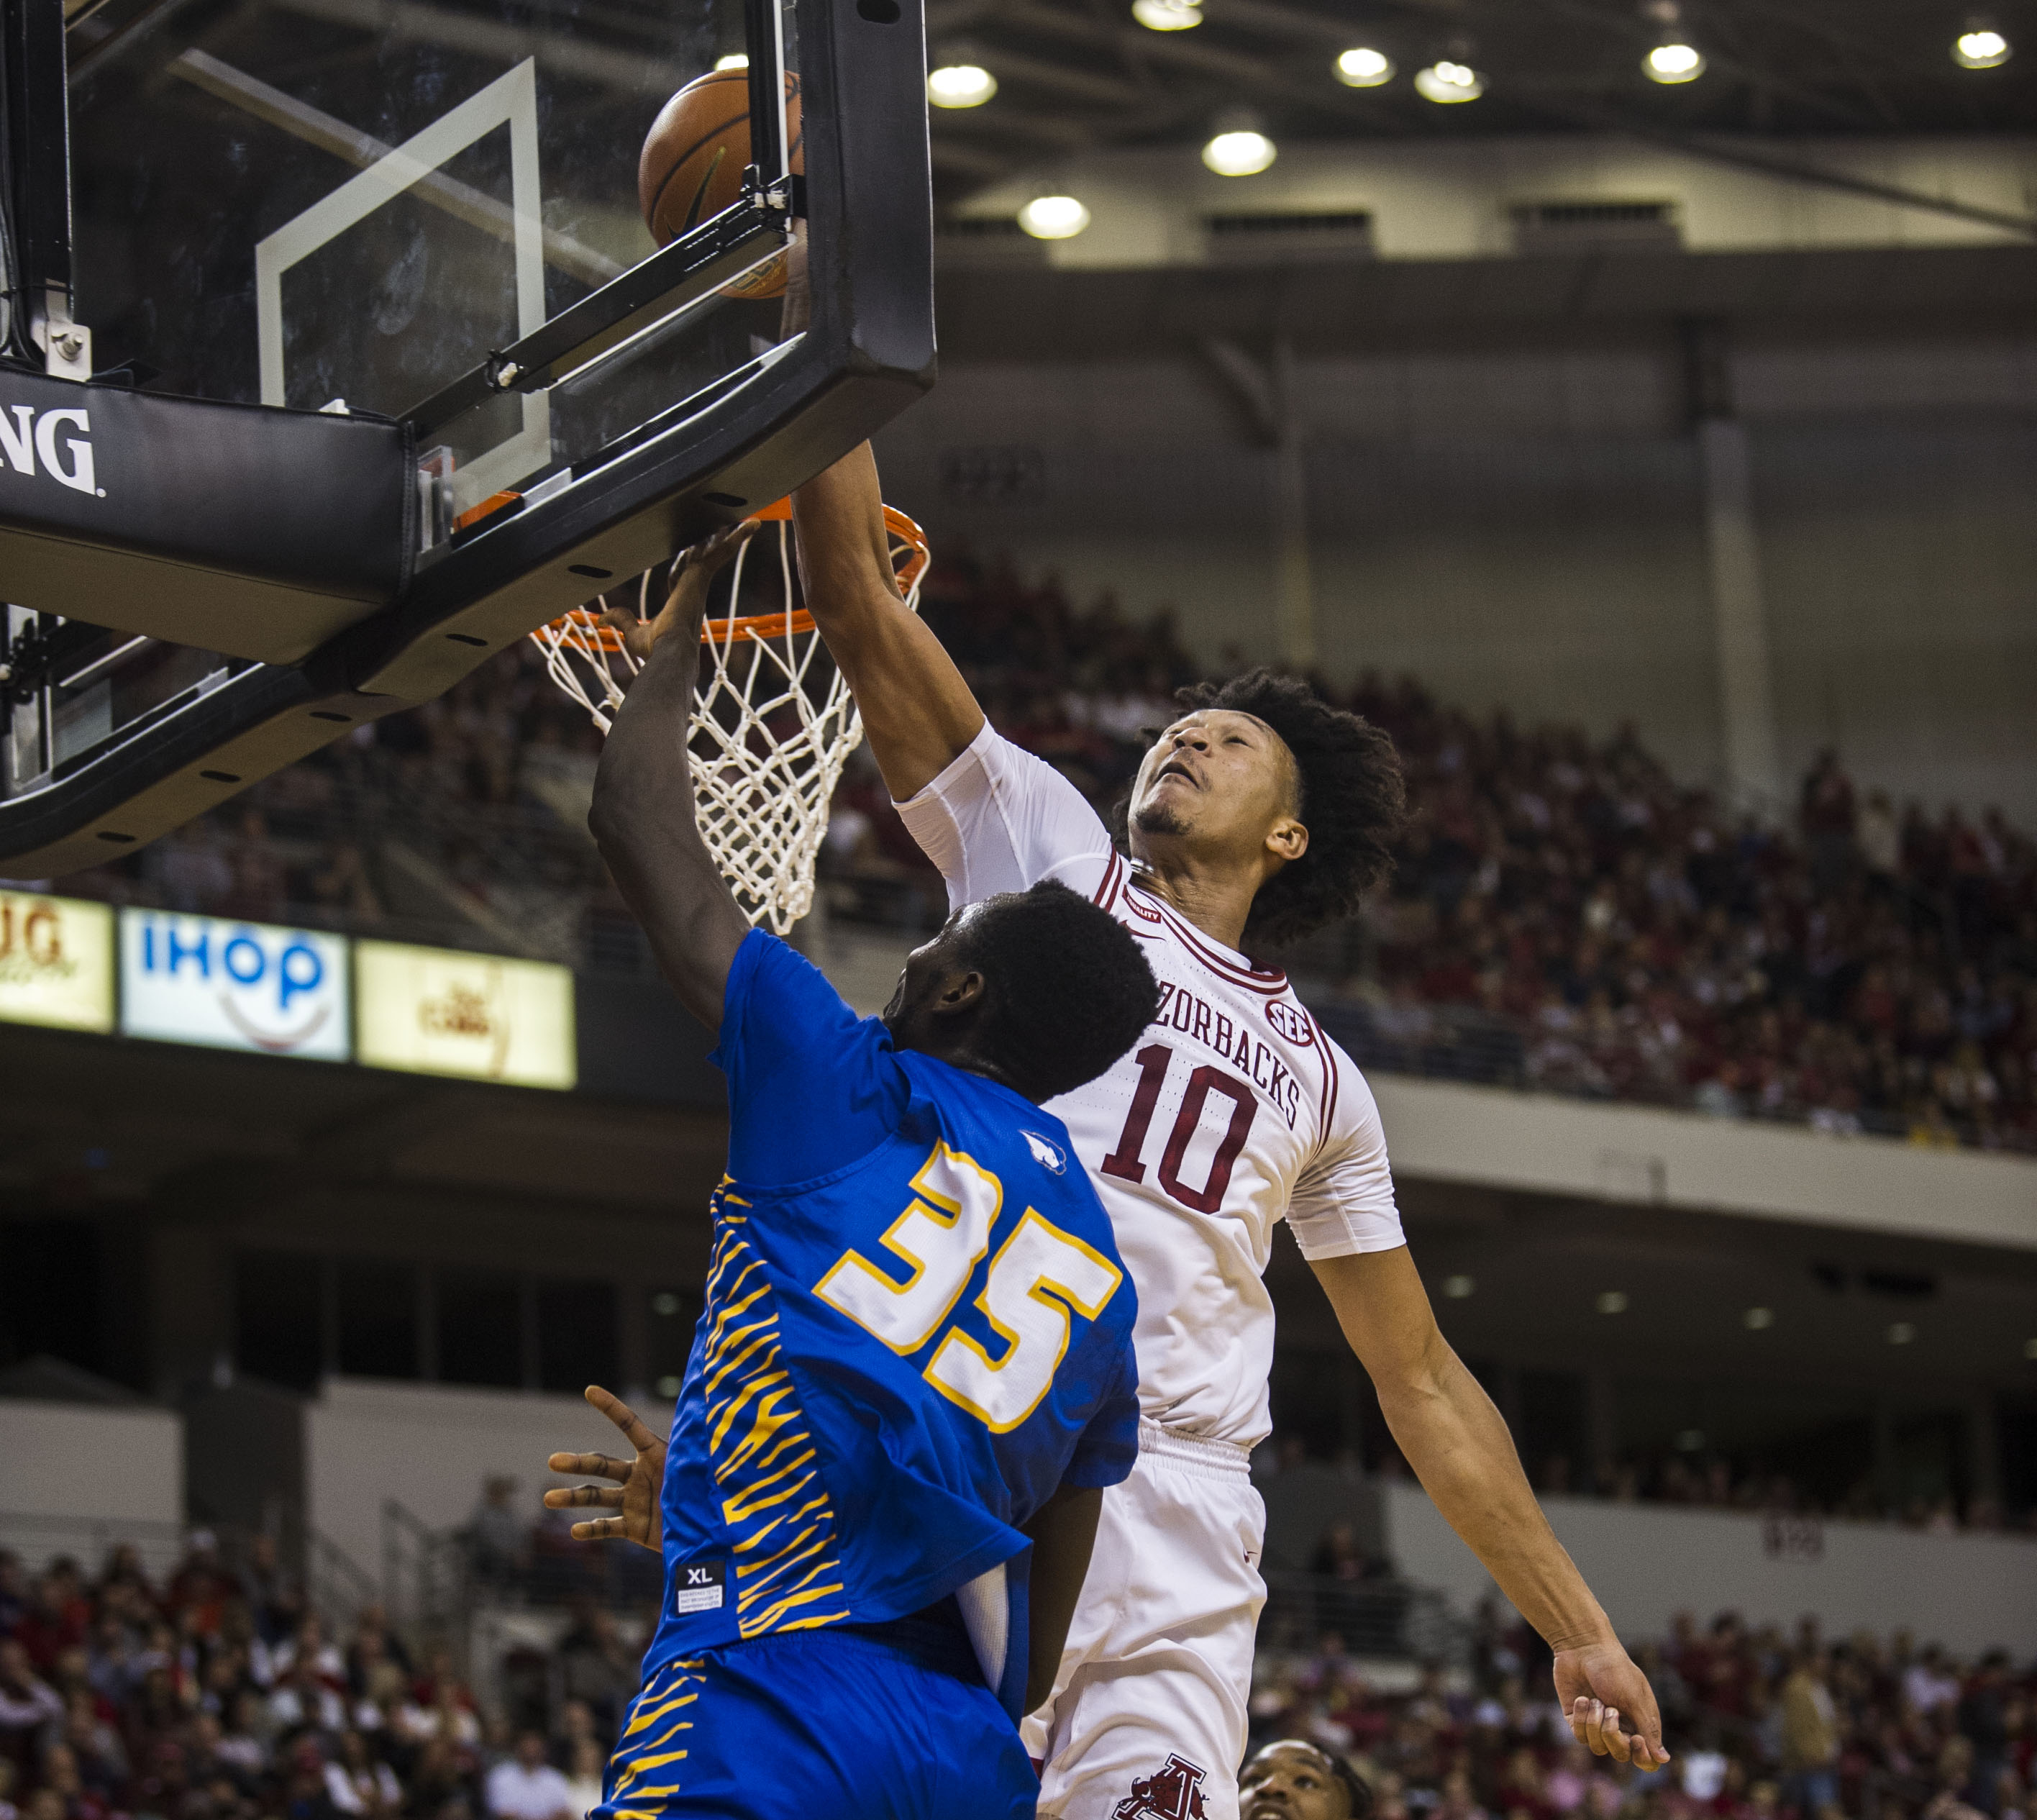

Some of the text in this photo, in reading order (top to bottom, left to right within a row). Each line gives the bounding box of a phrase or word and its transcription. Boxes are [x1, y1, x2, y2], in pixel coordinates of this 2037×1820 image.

[1269, 1003, 1311, 1043] SEC
[1100, 1044, 1259, 1214] 10
[811, 1137, 1124, 1434] 35
[688, 1568, 713, 1584] XL
